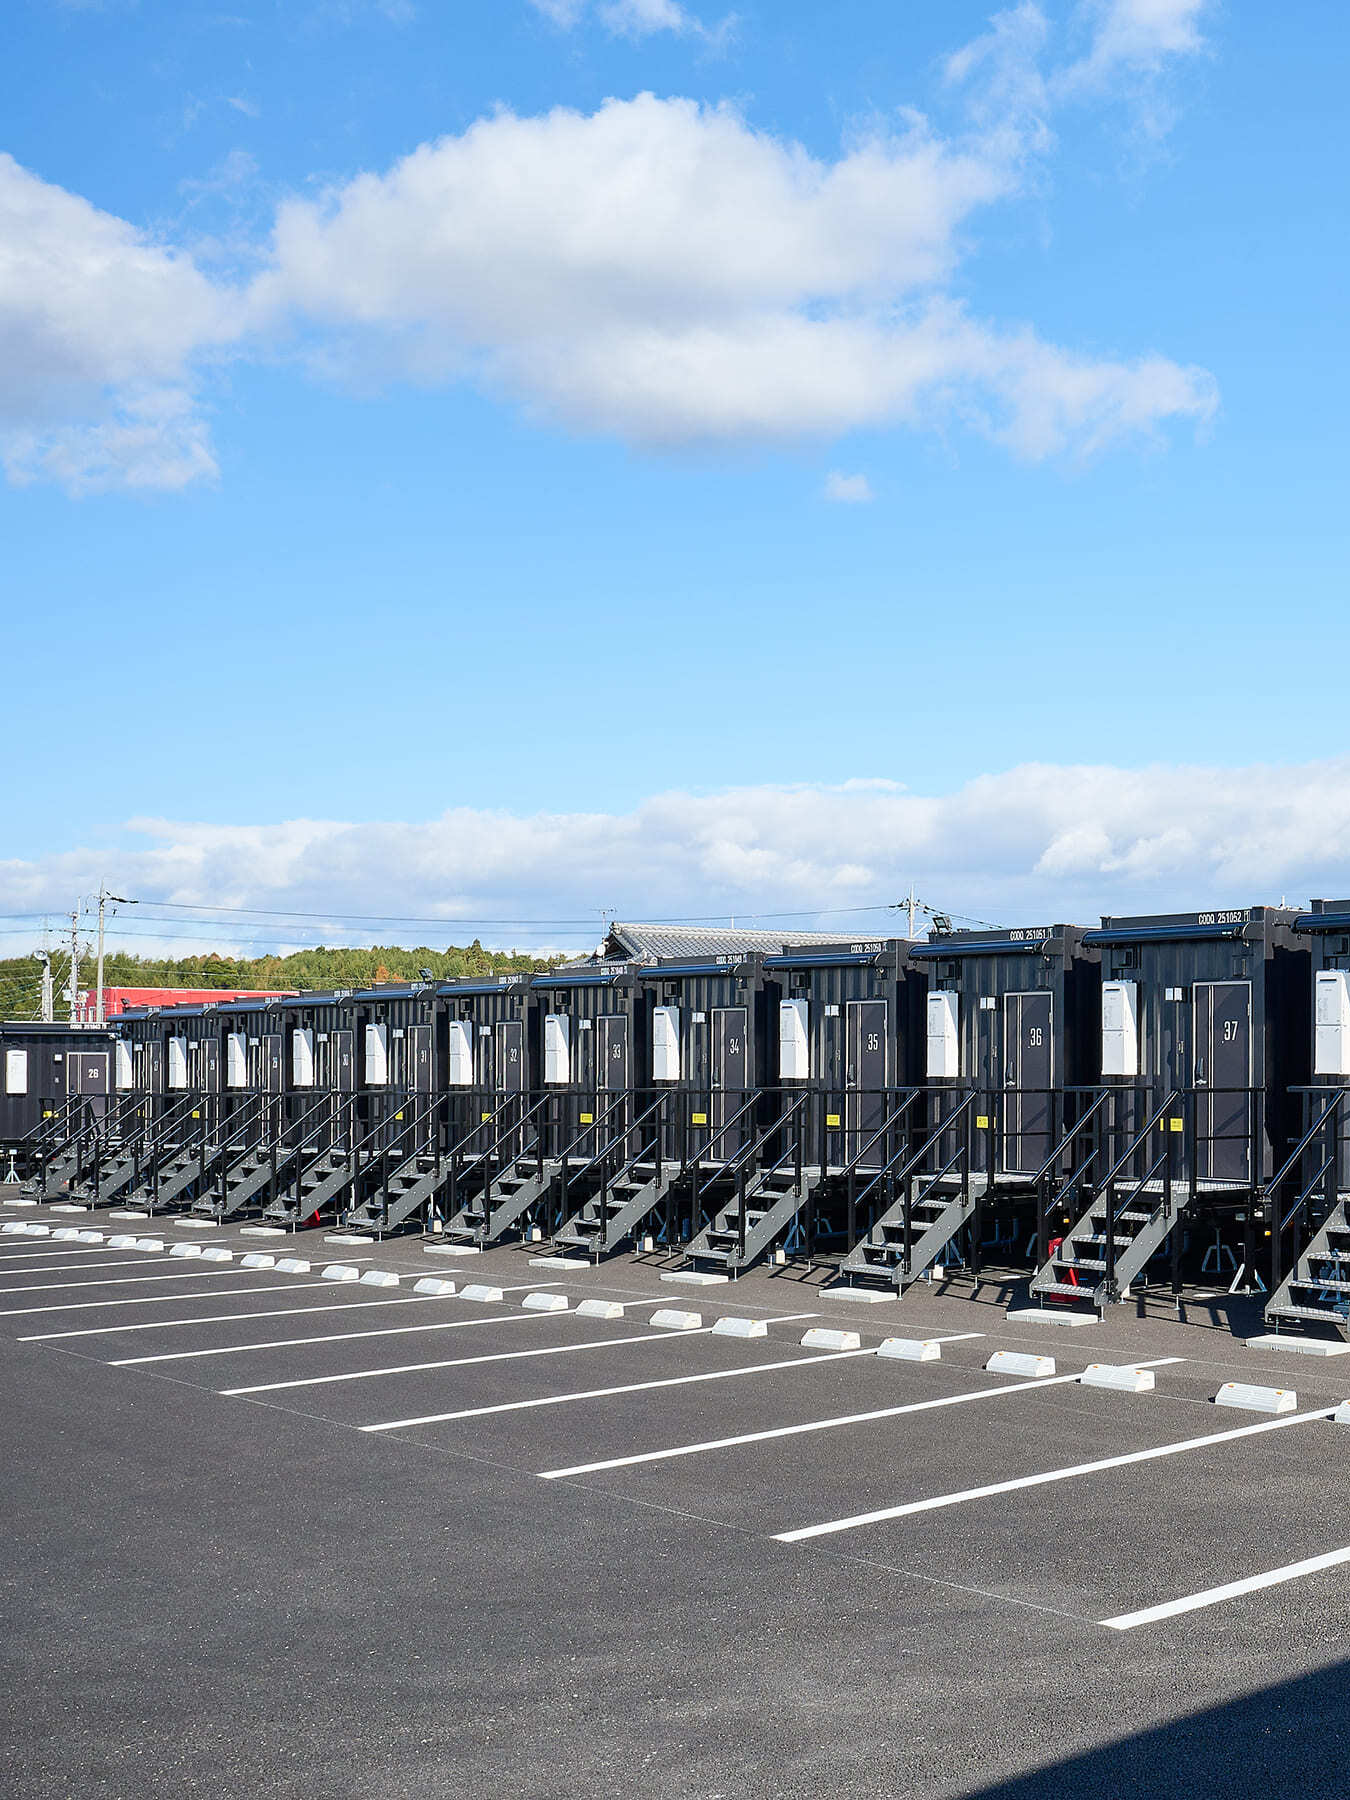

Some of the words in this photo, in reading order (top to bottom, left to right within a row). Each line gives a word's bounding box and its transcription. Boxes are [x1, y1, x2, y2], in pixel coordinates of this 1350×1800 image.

[1217, 911, 1242, 924] 251052
[1030, 1027, 1042, 1046] 36
[1224, 1020, 1239, 1041] 37
[729, 1038, 740, 1054] 34
[867, 1033, 879, 1051] 35
[510, 1048, 518, 1062] 32
[612, 1043, 621, 1059] 33
[88, 1068, 99, 1079] 26
